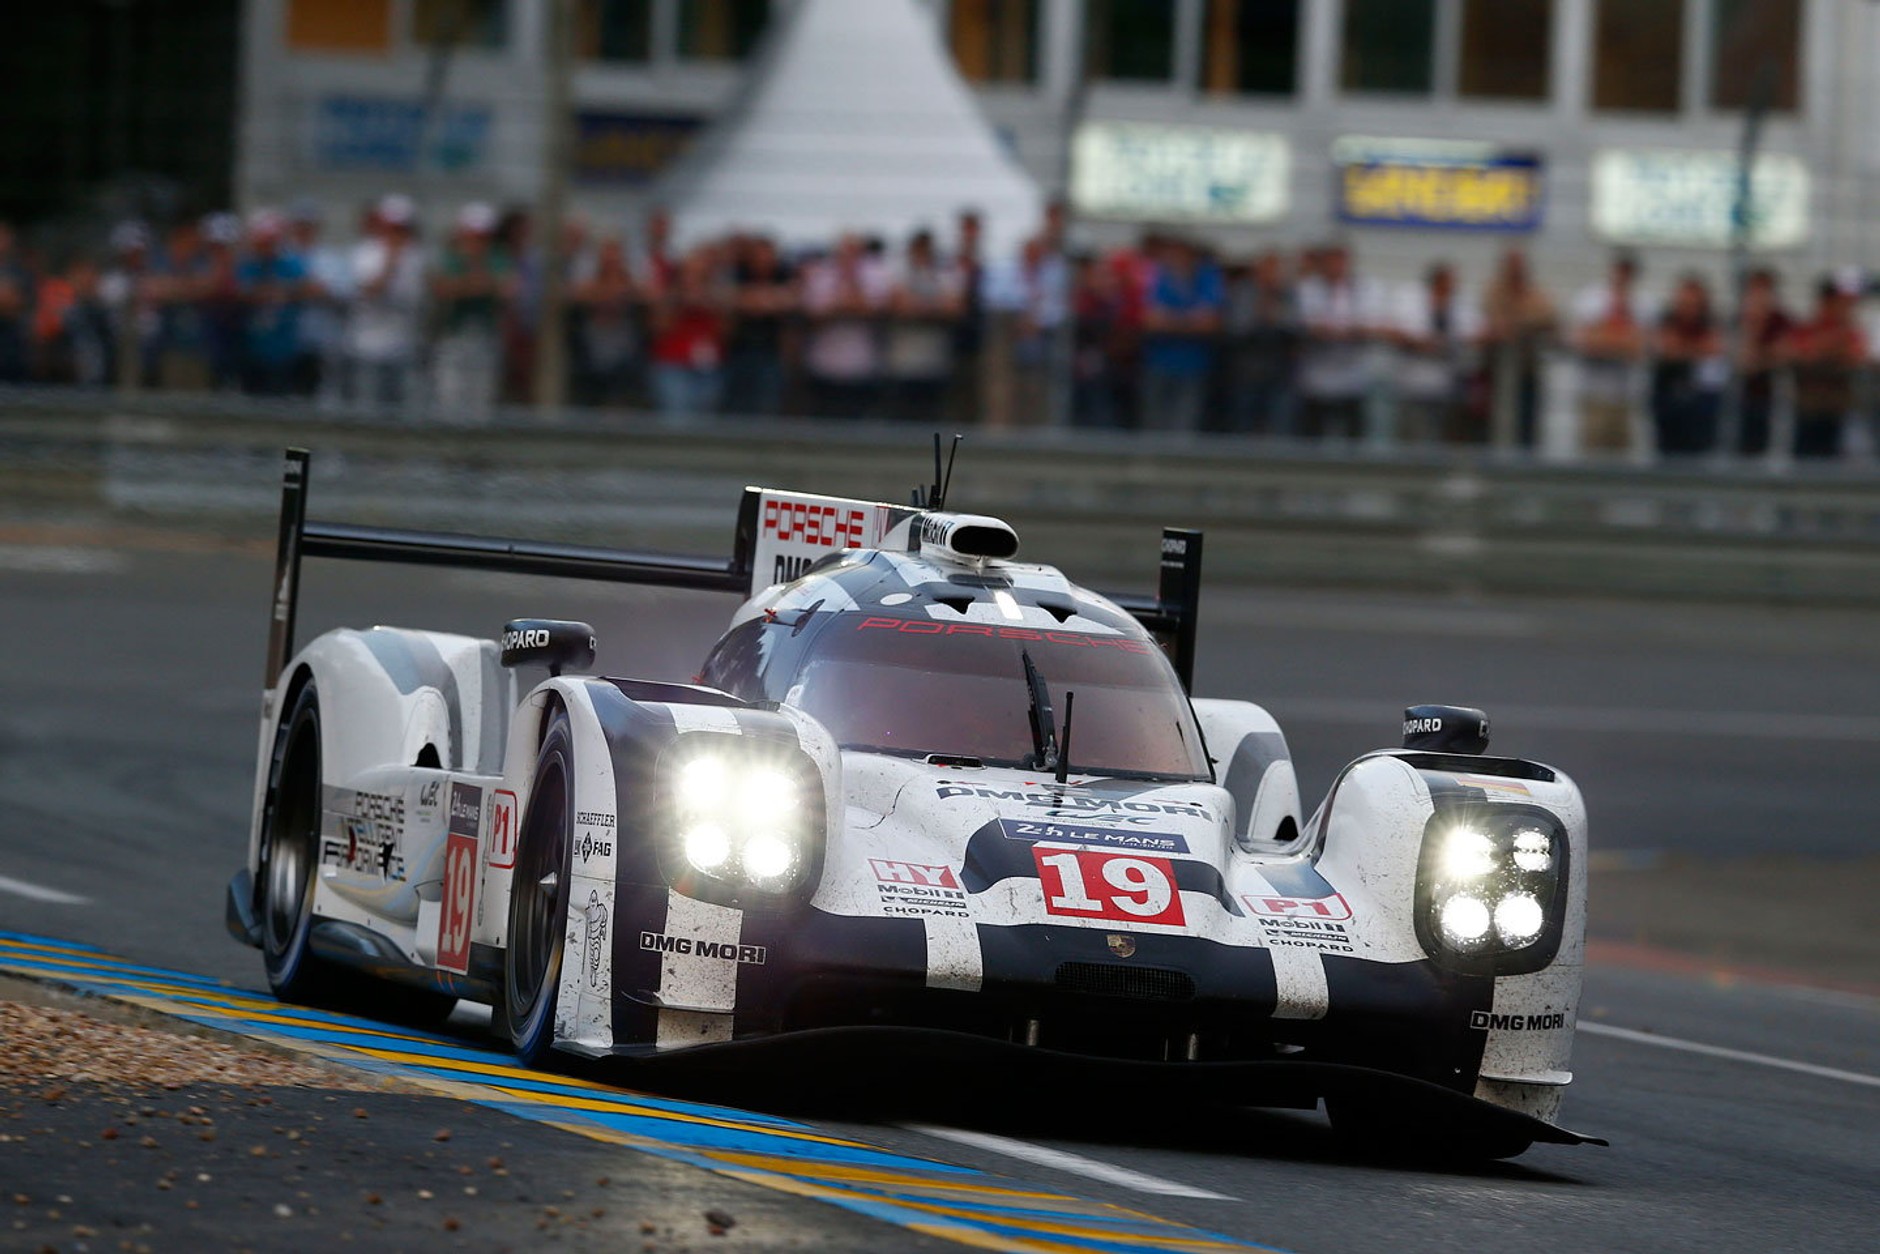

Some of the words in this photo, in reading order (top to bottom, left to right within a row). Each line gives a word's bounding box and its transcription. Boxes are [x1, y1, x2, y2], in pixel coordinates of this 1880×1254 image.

[763, 501, 865, 549] PORSCHE
[859, 617, 1153, 655] PORSCHE
[355, 791, 404, 824] PORSCHE
[1070, 798, 1214, 824] MORI
[492, 804, 510, 855] P1
[576, 811, 615, 828] SCHAEFFLER
[592, 841, 612, 857] FAG
[1070, 831, 1099, 840] LE
[1104, 834, 1175, 847] MANS
[870, 861, 947, 886] HY
[1041, 853, 1172, 916] 19
[441, 847, 471, 956] 19
[878, 884, 941, 898] Mobil
[883, 906, 970, 918] CHOPARD
[1263, 899, 1332, 916] P1
[1259, 918, 1322, 930] Mobil
[640, 931, 693, 955] DMG
[694, 940, 767, 965] MORI
[1269, 939, 1354, 953] CHOPARD
[1470, 1011, 1525, 1031] DMG
[1526, 1013, 1565, 1031] MORI
